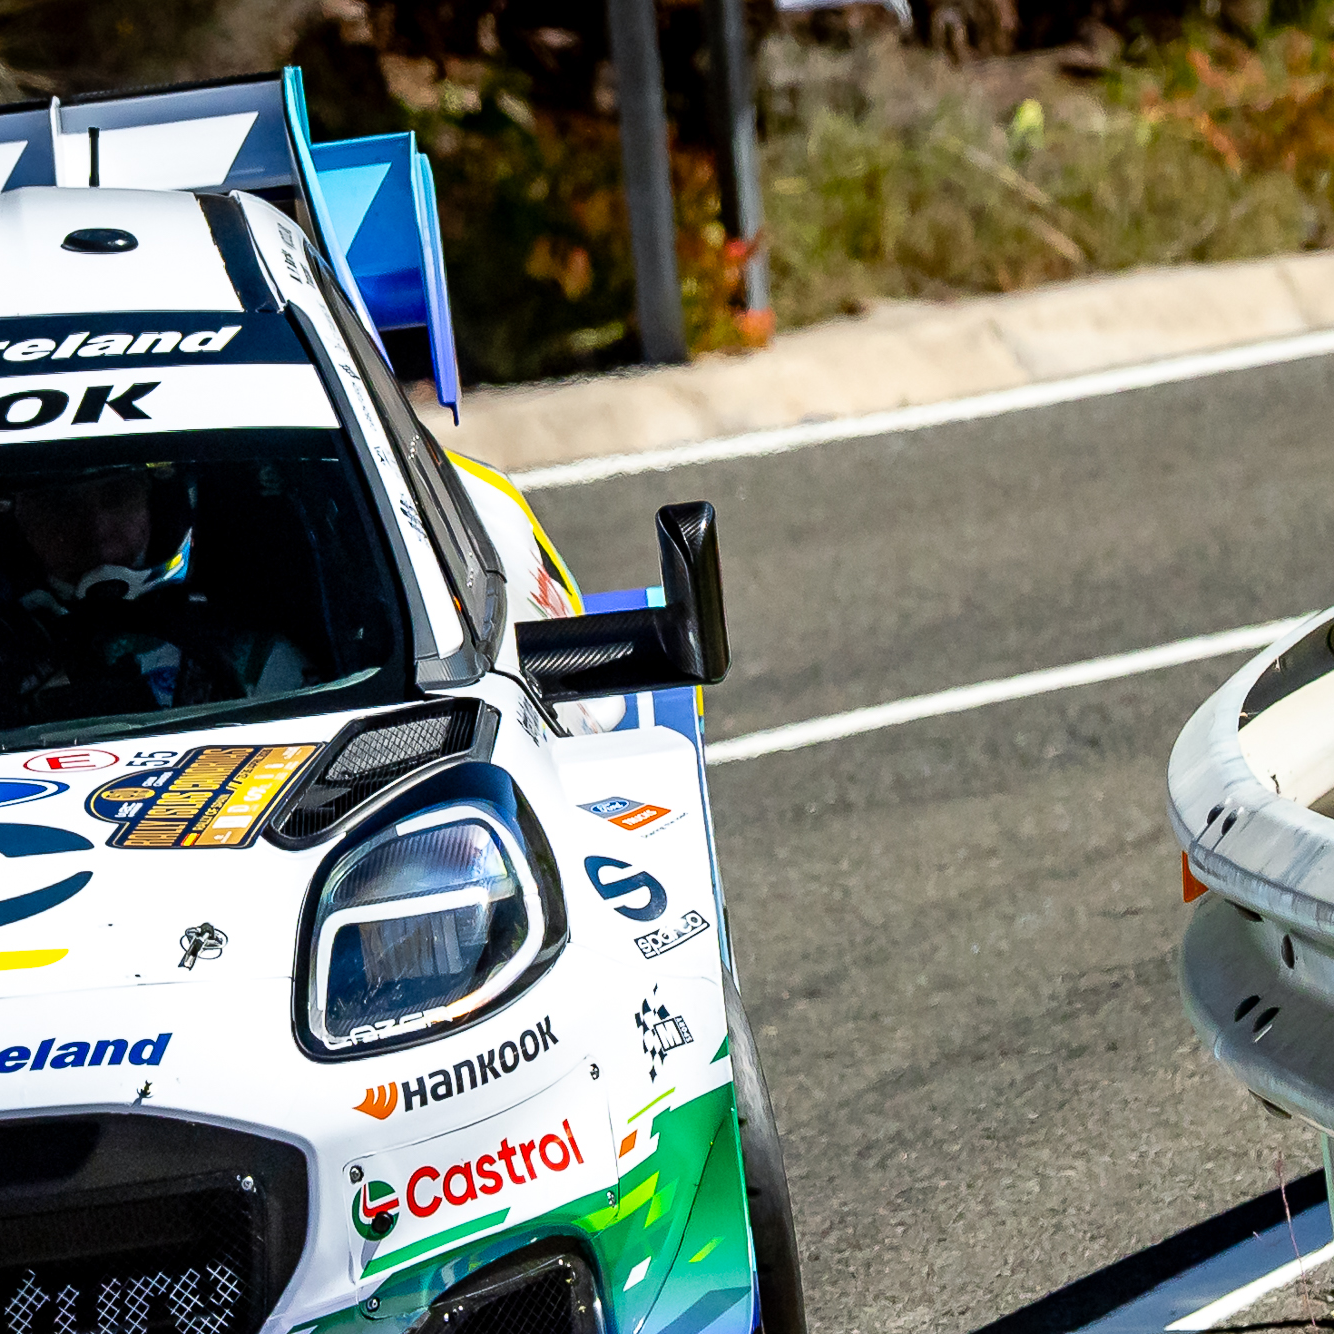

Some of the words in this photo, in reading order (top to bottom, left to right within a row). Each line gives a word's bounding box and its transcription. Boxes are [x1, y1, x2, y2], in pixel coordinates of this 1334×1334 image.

[124, 751, 178, 766] 55
[144, 791, 213, 818] ISLAS
[122, 820, 190, 846] RALLY
[637, 911, 704, 956] sparco
[655, 1020, 683, 1050] M
[406, 1118, 585, 1218] Castrol
